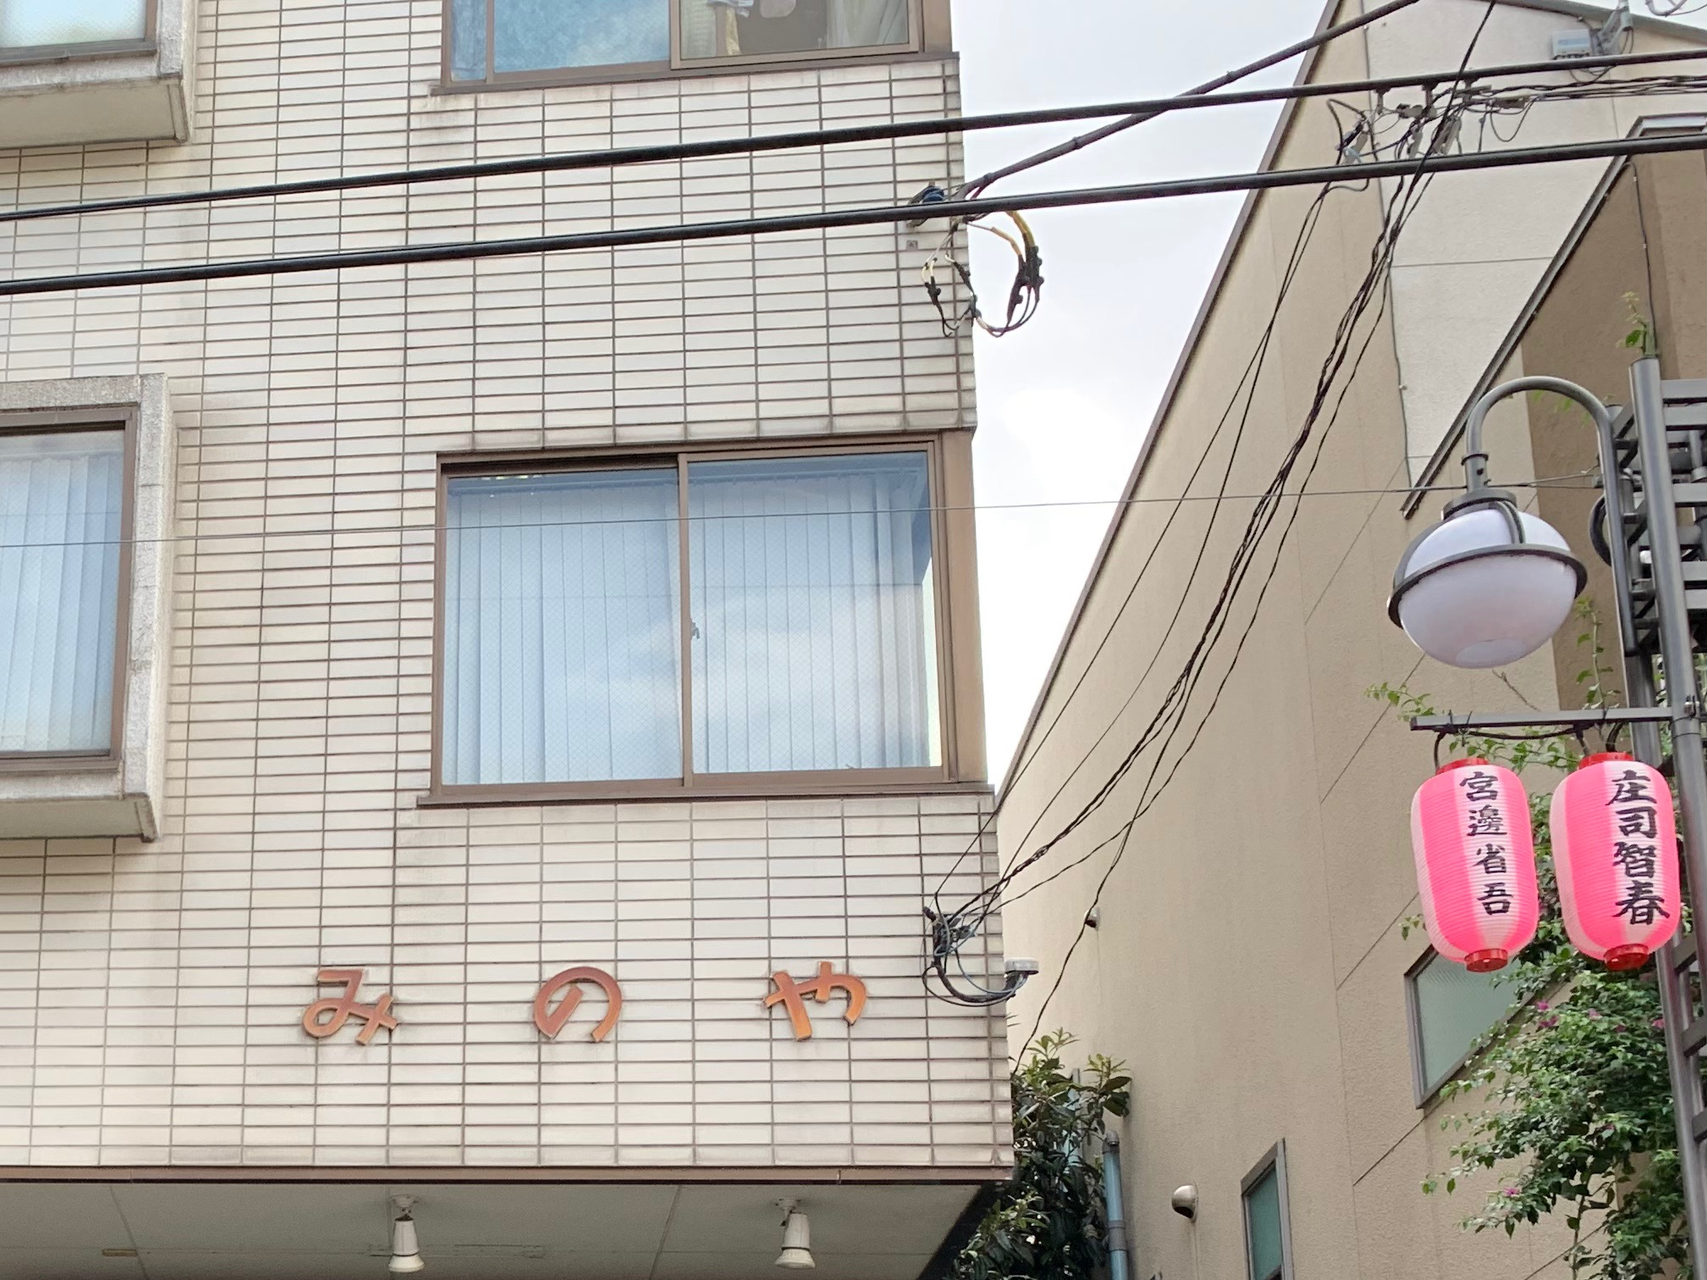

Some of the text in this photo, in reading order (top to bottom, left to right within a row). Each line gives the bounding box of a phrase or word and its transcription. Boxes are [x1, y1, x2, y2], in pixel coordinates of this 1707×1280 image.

[1605, 769, 1671, 926] 庄司智春
[302, 961, 868, 1046] みのや
